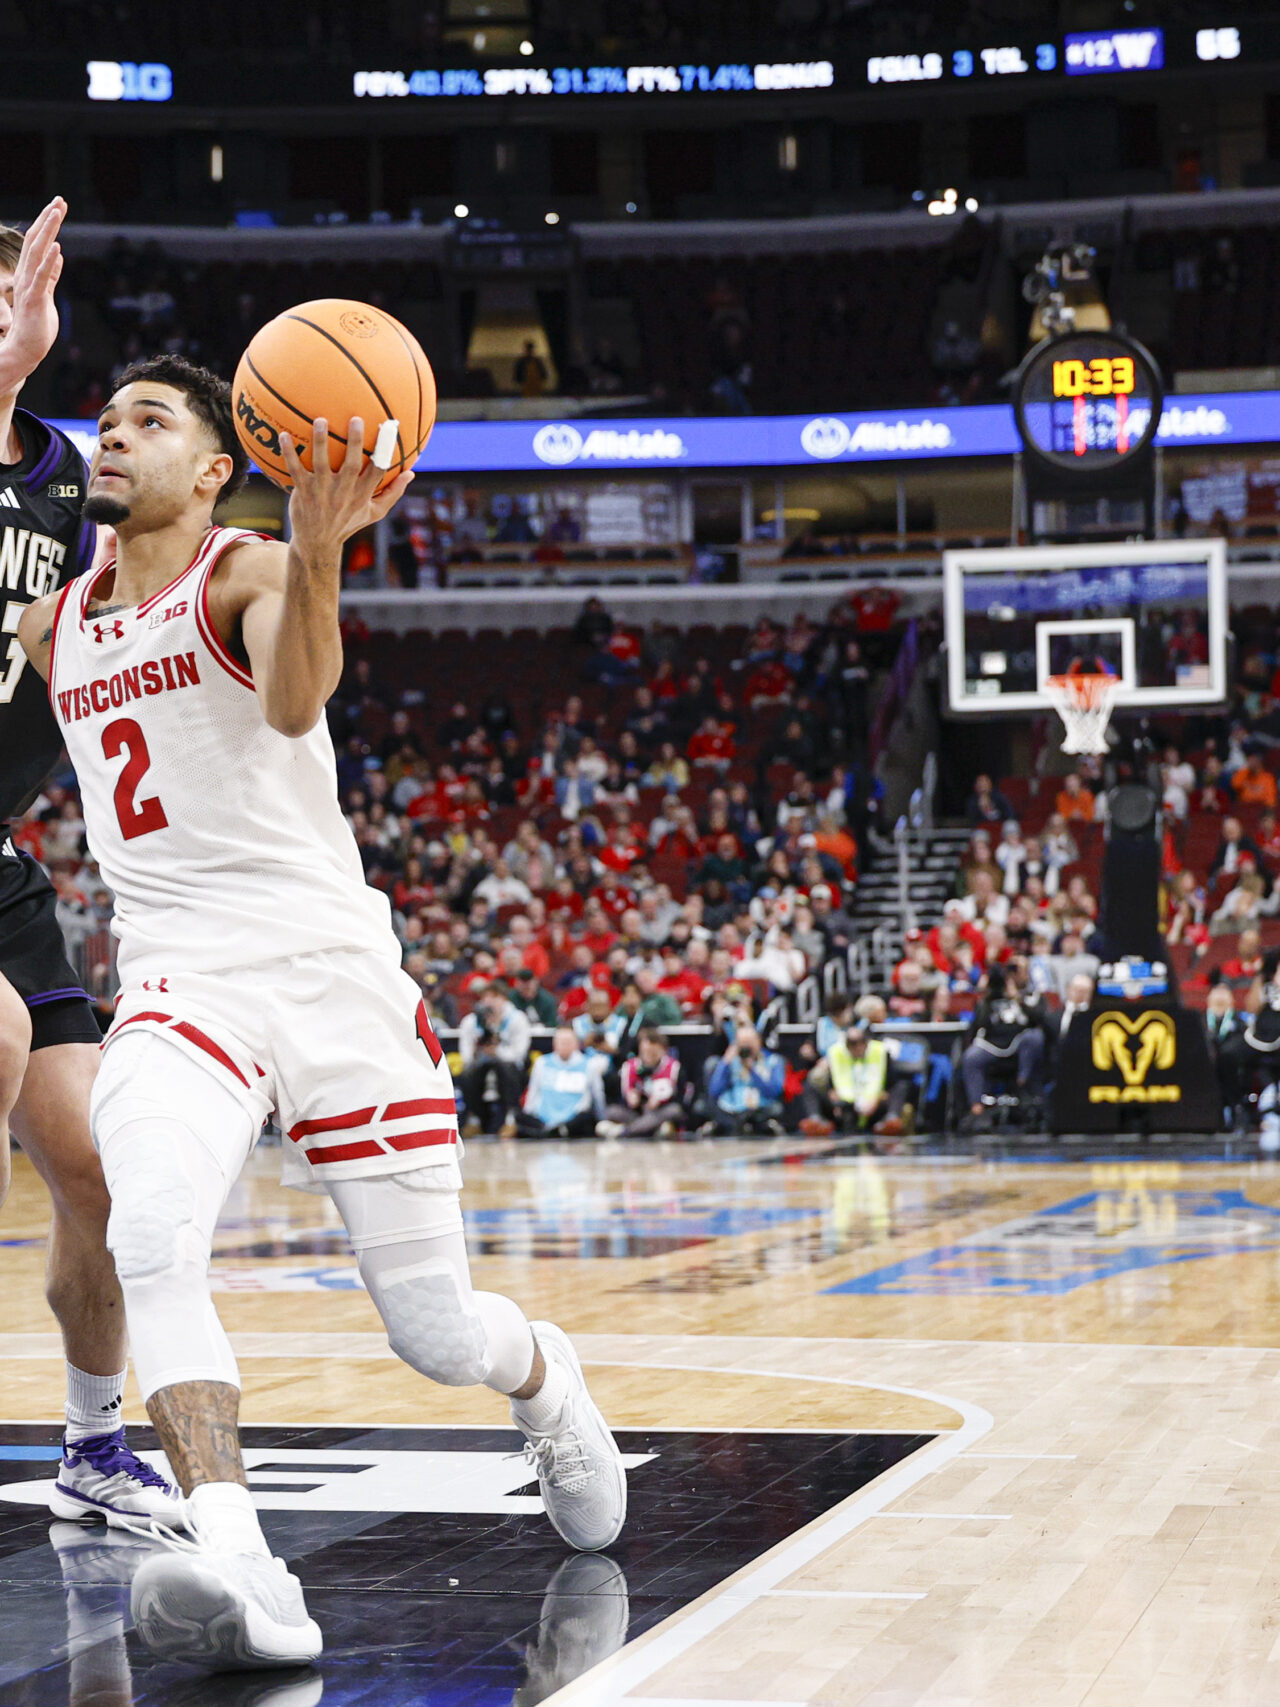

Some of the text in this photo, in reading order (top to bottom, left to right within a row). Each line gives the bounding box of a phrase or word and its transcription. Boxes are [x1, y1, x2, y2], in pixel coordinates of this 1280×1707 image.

[1052, 357, 1135, 397] 10:33
[580, 429, 682, 459] Allstate
[848, 420, 950, 452] Allstate
[57, 651, 201, 725] WISCONSIN
[100, 718, 169, 841] 2
